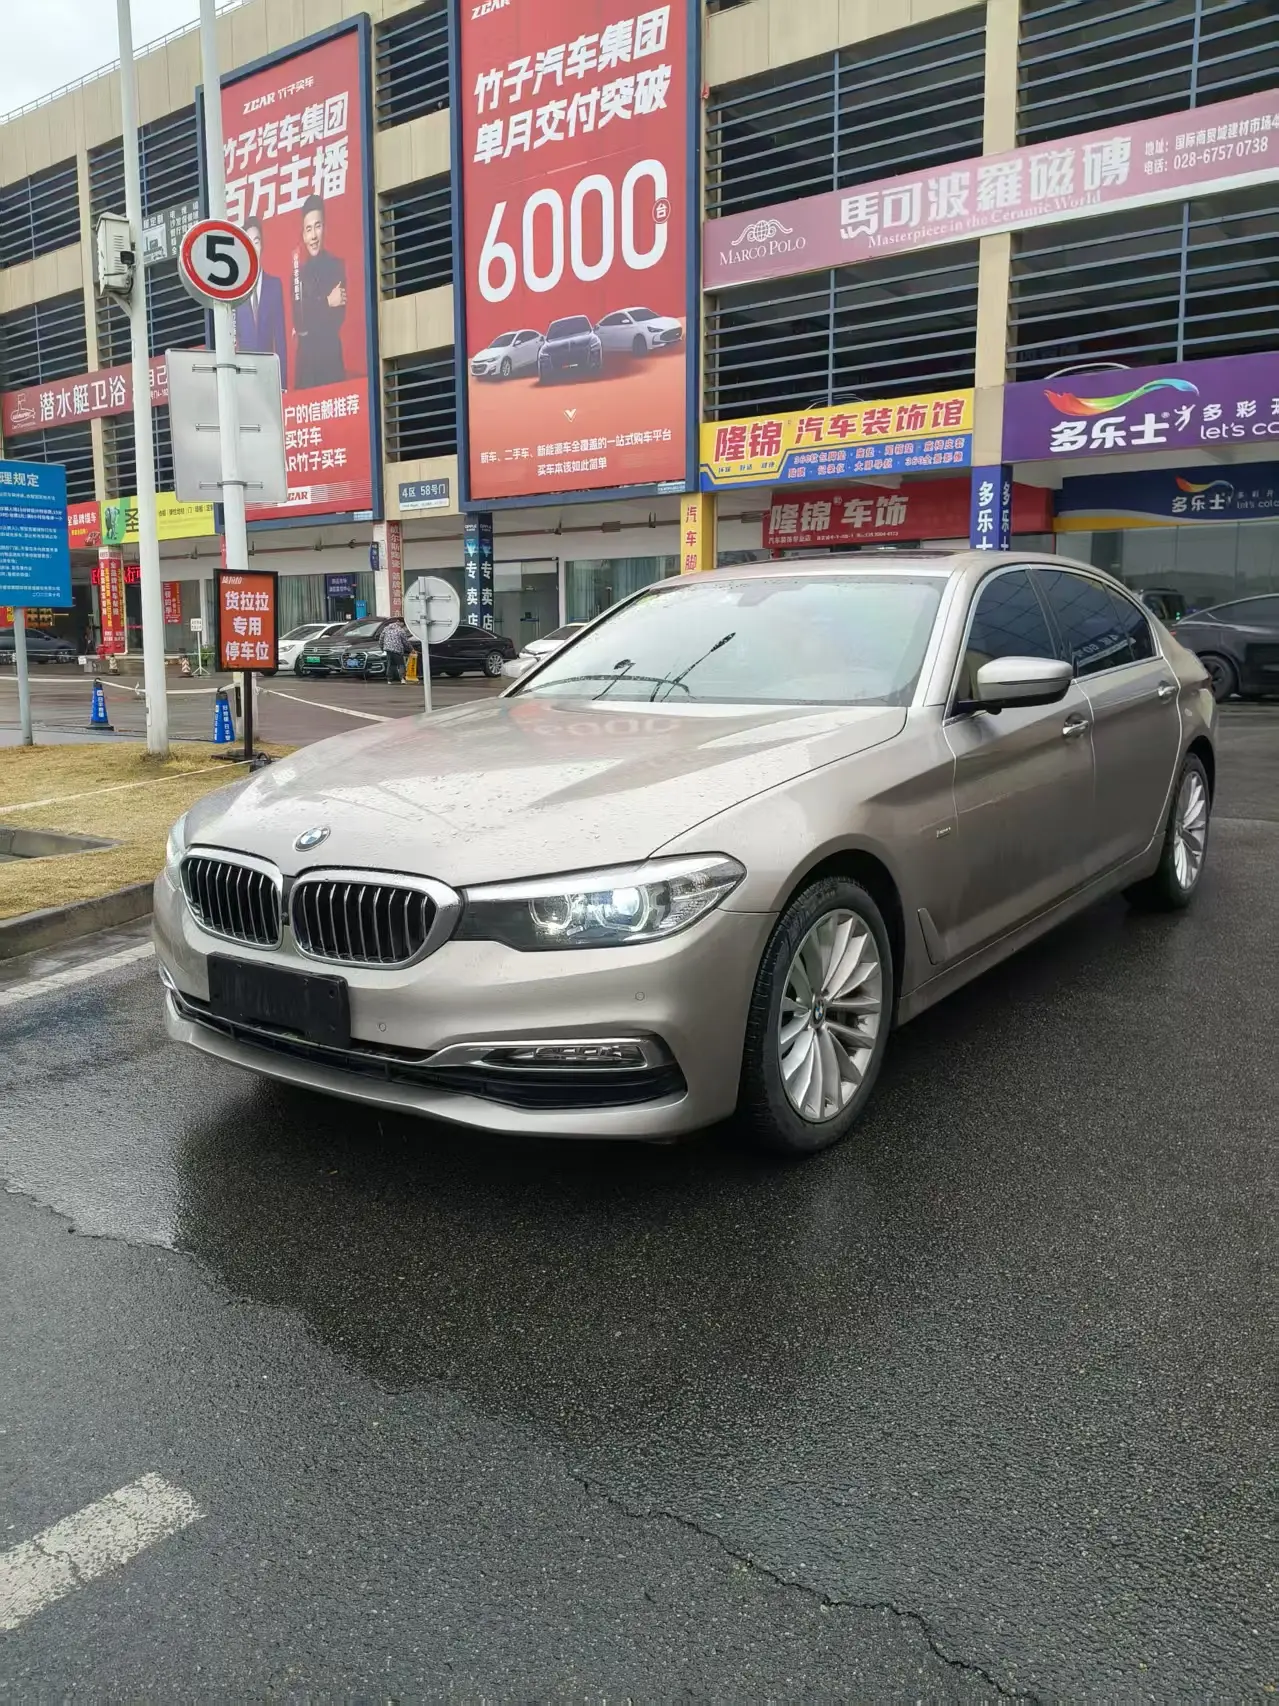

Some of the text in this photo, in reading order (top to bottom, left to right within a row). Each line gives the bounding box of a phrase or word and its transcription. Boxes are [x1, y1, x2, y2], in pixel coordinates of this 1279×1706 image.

[474, 5, 670, 114] 竹子汽车集团
[243, 92, 275, 115] ZCAR
[474, 63, 672, 164] 单月交付突破
[1174, 144, 1234, 170] 028-6757
[1236, 136, 1268, 157] 0738
[840, 137, 1131, 239] 馬可波羅磁磚
[1055, 190, 1101, 210] World
[655, 202, 668, 219] 台
[478, 158, 668, 303] 6000
[206, 235, 239, 286] 5
[720, 237, 806, 266] MARCO POLO
[40, 375, 125, 422] 潜水艇卫浴
[285, 426, 323, 450] 买好车
[714, 398, 966, 464] 隆锦 汽车装饰馆
[1049, 414, 1170, 453] 多乐士
[1200, 423, 1245, 440] let's
[537, 457, 608, 476] 买车本该如此简单
[420, 484, 446, 496] 58号门
[1172, 493, 1226, 513] 多乐士
[769, 494, 909, 535] 隆锦 车饰
[225, 591, 270, 611] 货拉拉
[481, 561, 493, 633] 专卖店
[233, 616, 262, 636] 专用
[225, 641, 270, 661] 停车位
